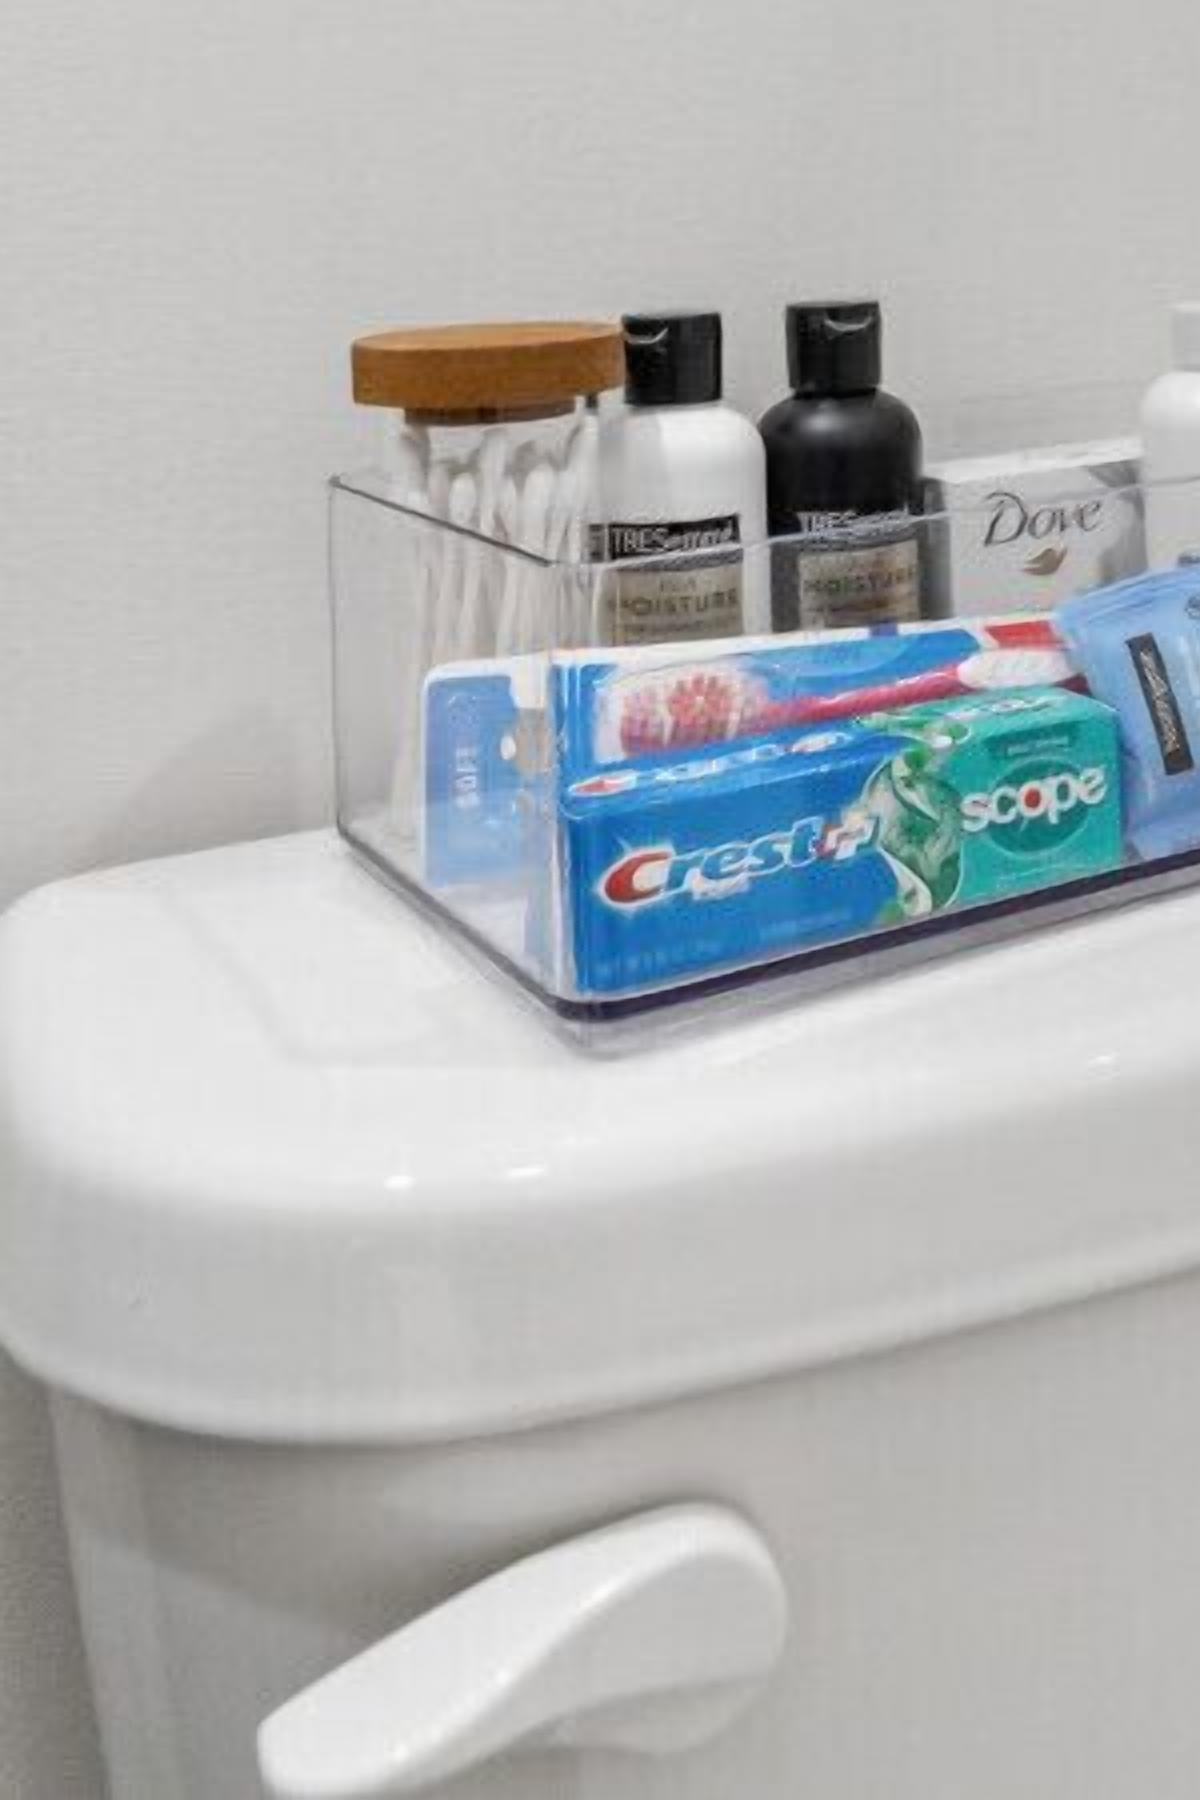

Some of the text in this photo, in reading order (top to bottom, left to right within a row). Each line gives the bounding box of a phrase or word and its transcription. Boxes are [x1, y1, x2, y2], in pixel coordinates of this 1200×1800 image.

[983, 491, 1101, 547] Dove
[960, 766, 1108, 832] scope
[602, 814, 823, 904] Crest
